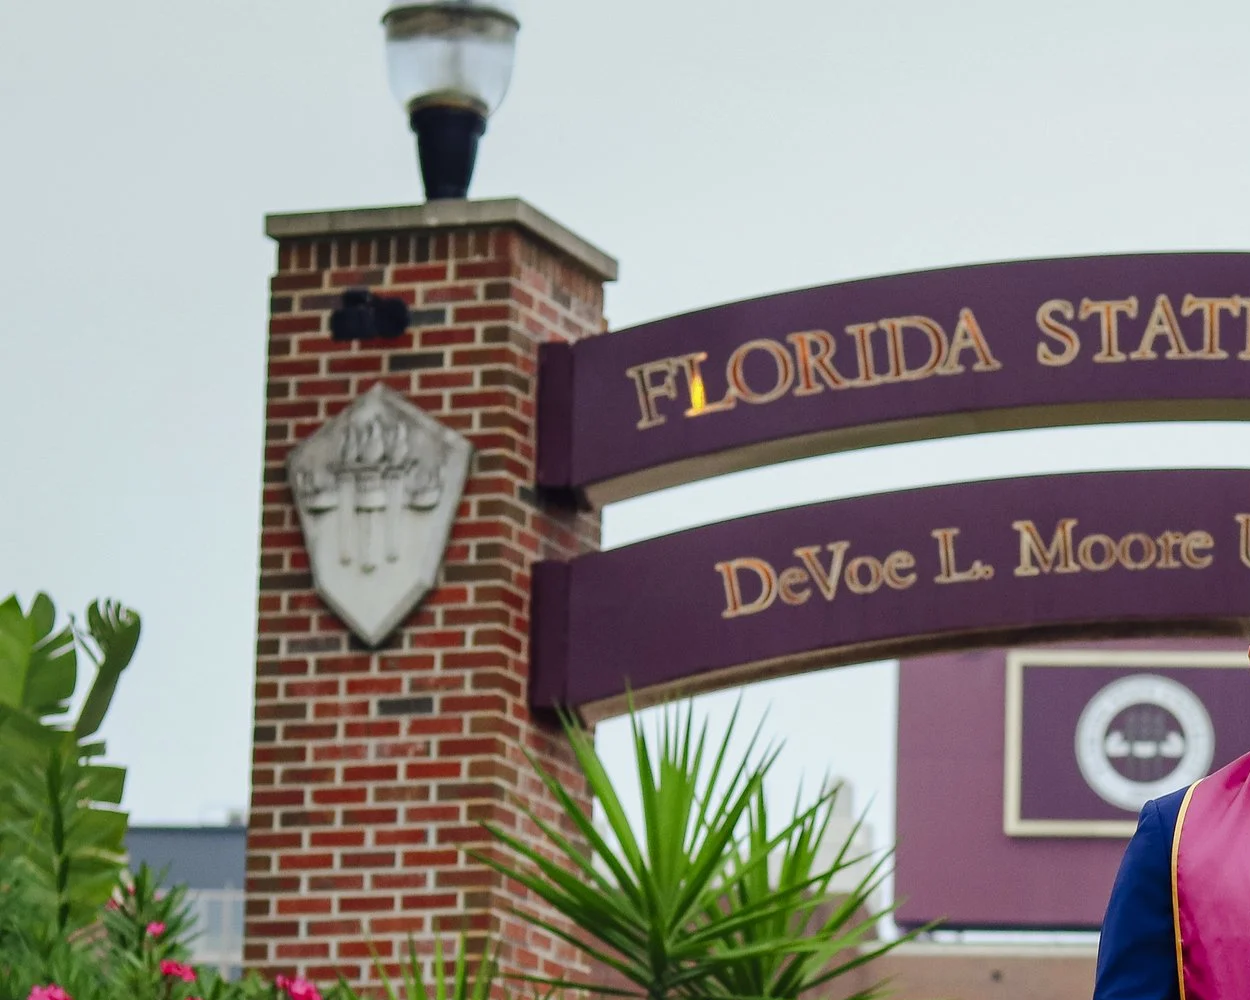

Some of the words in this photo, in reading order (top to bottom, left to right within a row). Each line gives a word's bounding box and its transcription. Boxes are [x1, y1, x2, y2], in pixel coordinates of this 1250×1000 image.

[626, 307, 1001, 431] FLORIDA
[715, 541, 917, 619] DeVoe
[932, 528, 994, 584] L.
[1012, 518, 1214, 577] Moore
